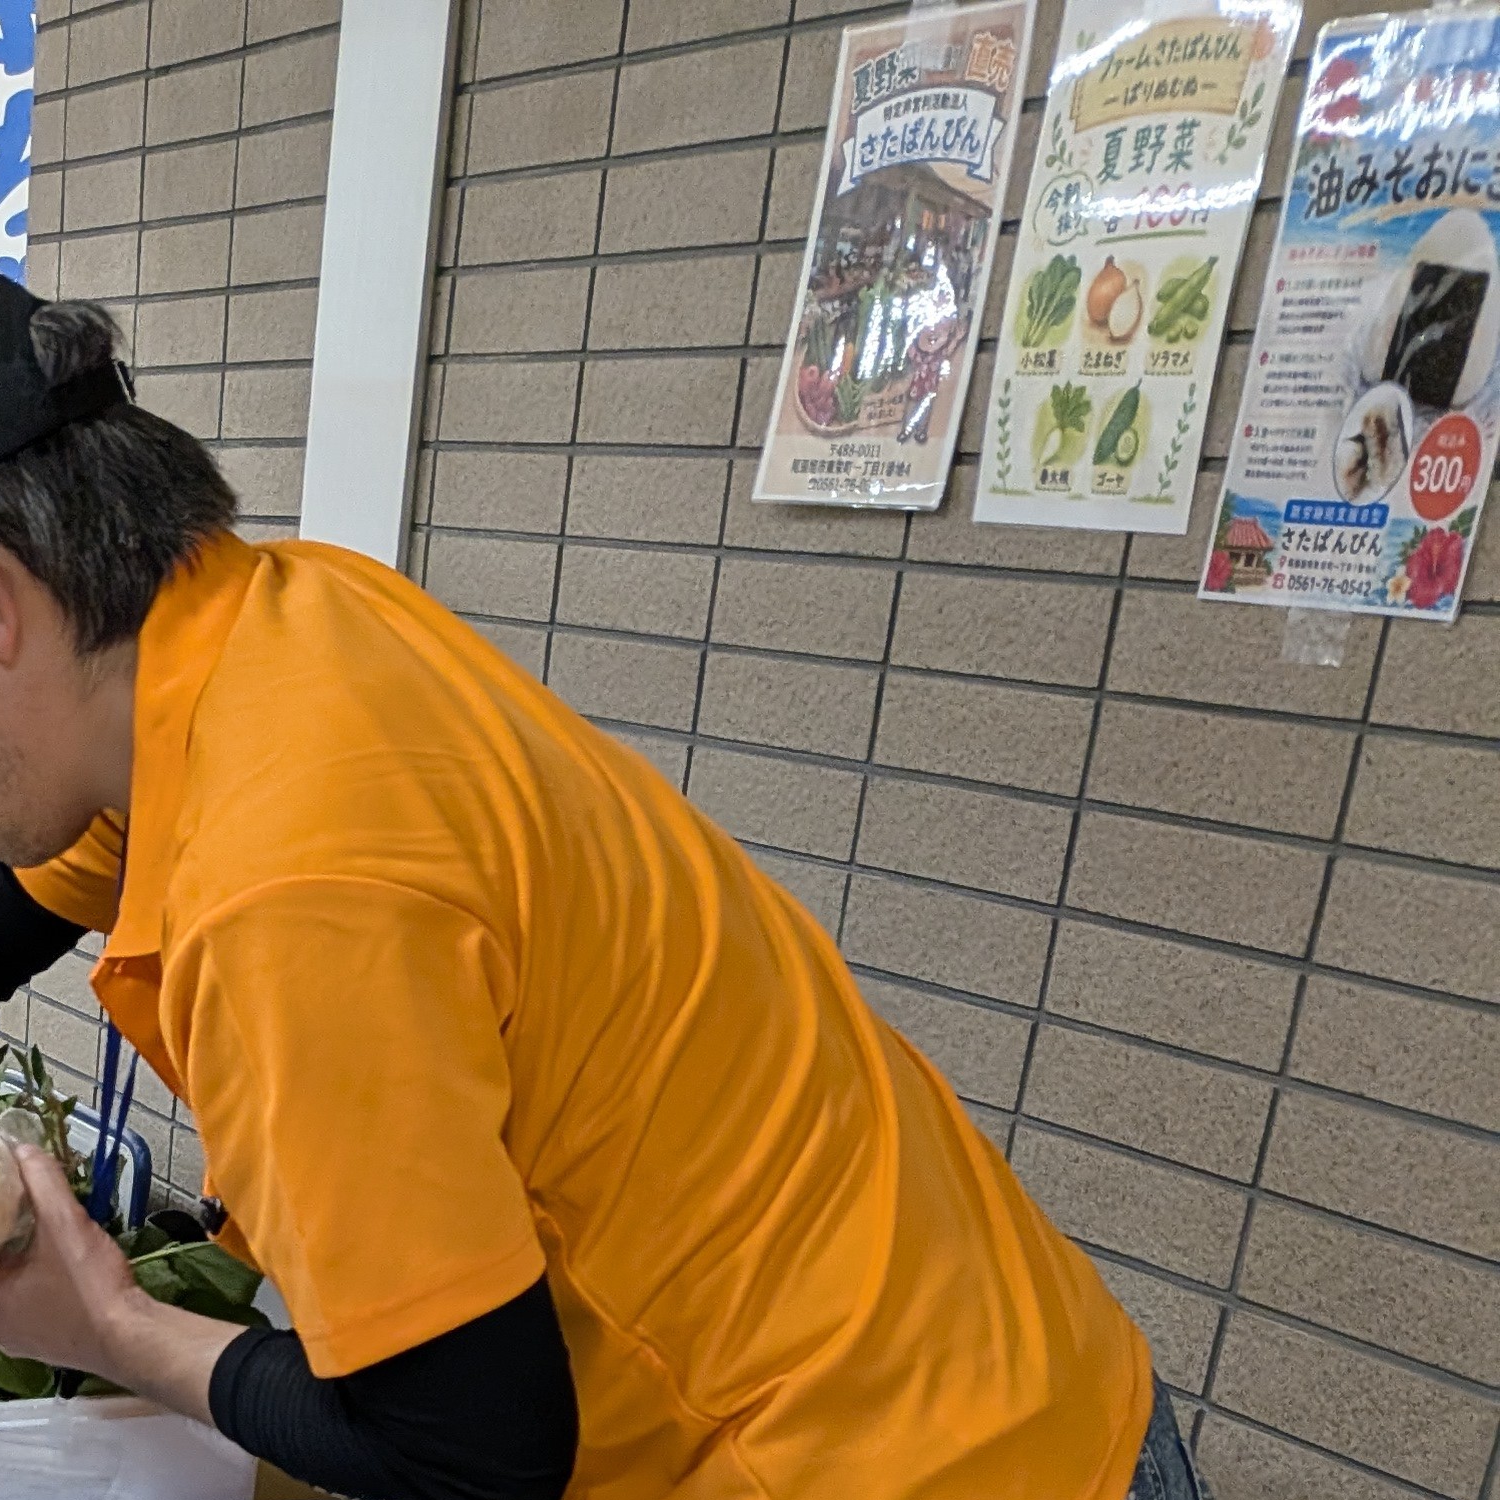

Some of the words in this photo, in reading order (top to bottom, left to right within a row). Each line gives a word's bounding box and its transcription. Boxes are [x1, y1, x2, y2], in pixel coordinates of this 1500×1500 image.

[1096, 117, 1202, 185] 夏野菜
[1084, 350, 1127, 369] たまねぎ
[1281, 527, 1383, 557] さたぱんびん
